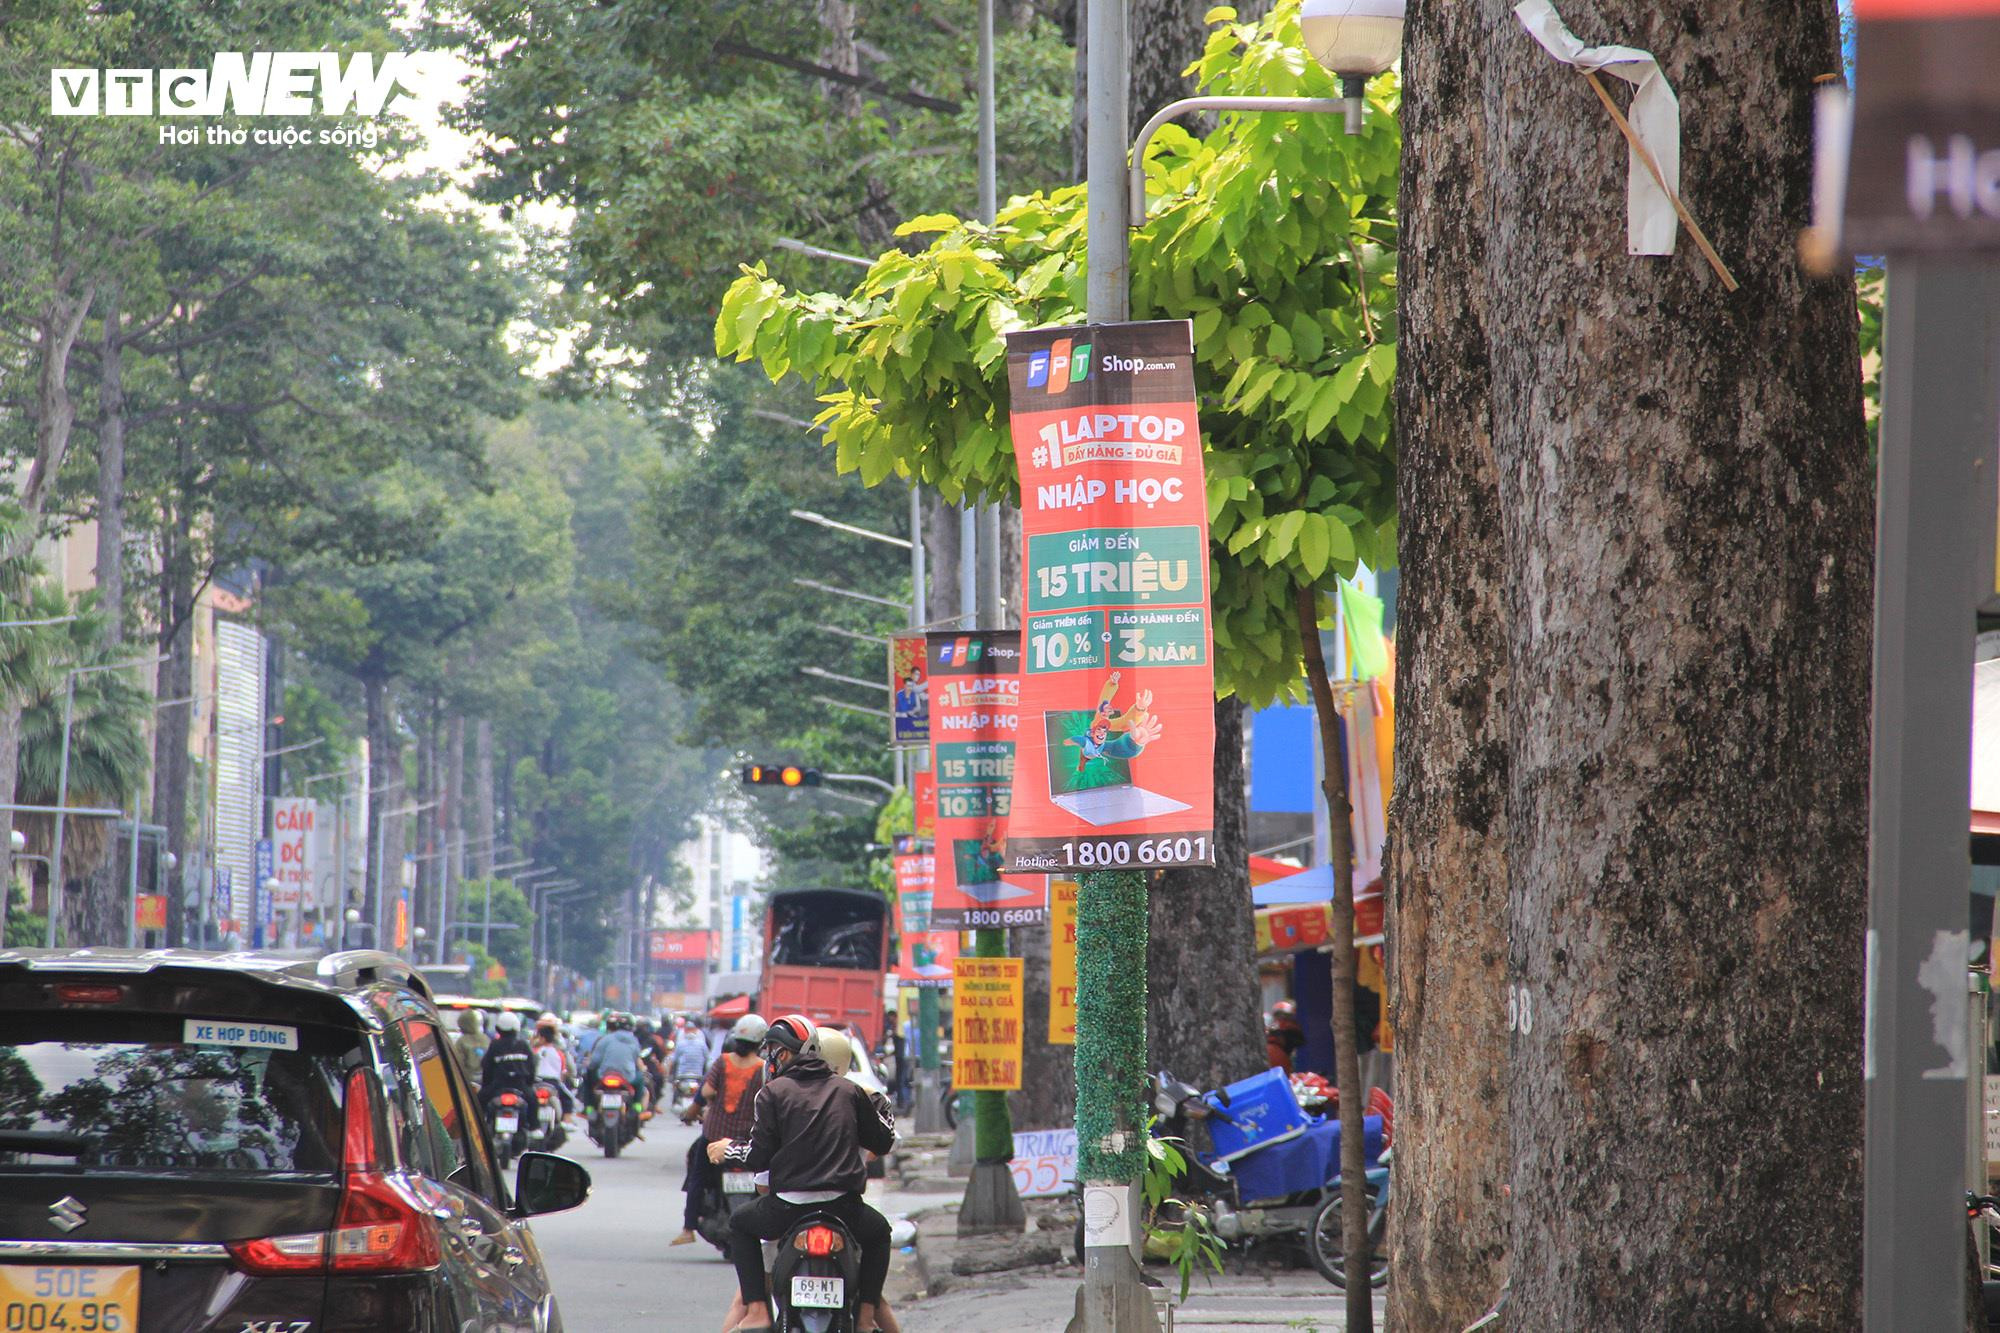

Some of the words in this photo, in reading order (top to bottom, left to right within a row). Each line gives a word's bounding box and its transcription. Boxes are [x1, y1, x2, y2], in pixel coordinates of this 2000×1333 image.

[1028, 344, 1091, 386] FPT
[1060, 415, 1185, 445] LAPTOP
[1156, 448, 1177, 462] GIÁ
[1037, 474, 1106, 511] NHẬP
[1114, 477, 1184, 508] HỌC
[1069, 534, 1099, 552] GIẢM
[1104, 532, 1139, 549] ĐẾN
[1037, 565, 1068, 598] 15
[1072, 552, 1188, 599] TRIỆU
[1114, 613, 1137, 624] BẢO
[1176, 610, 1199, 623] ĐẾN
[940, 640, 982, 664] FPT
[1118, 629, 1145, 662] 3
[1148, 642, 1196, 661] NĂM
[942, 711, 990, 732] NHẬP
[943, 760, 966, 777] 15
[1016, 856, 1058, 868] Hotline:
[1063, 842, 1130, 867] 1800
[1138, 837, 1206, 865] 6601
[963, 911, 1000, 924] 1800
[1003, 909, 1042, 924] 6601
[196, 1027, 213, 1039] XE
[217, 1027, 245, 1044] HỢP
[35, 1269, 97, 1297] 50E
[800, 1280, 834, 1292] 69-N1
[6, 1303, 122, 1332] 004.96
